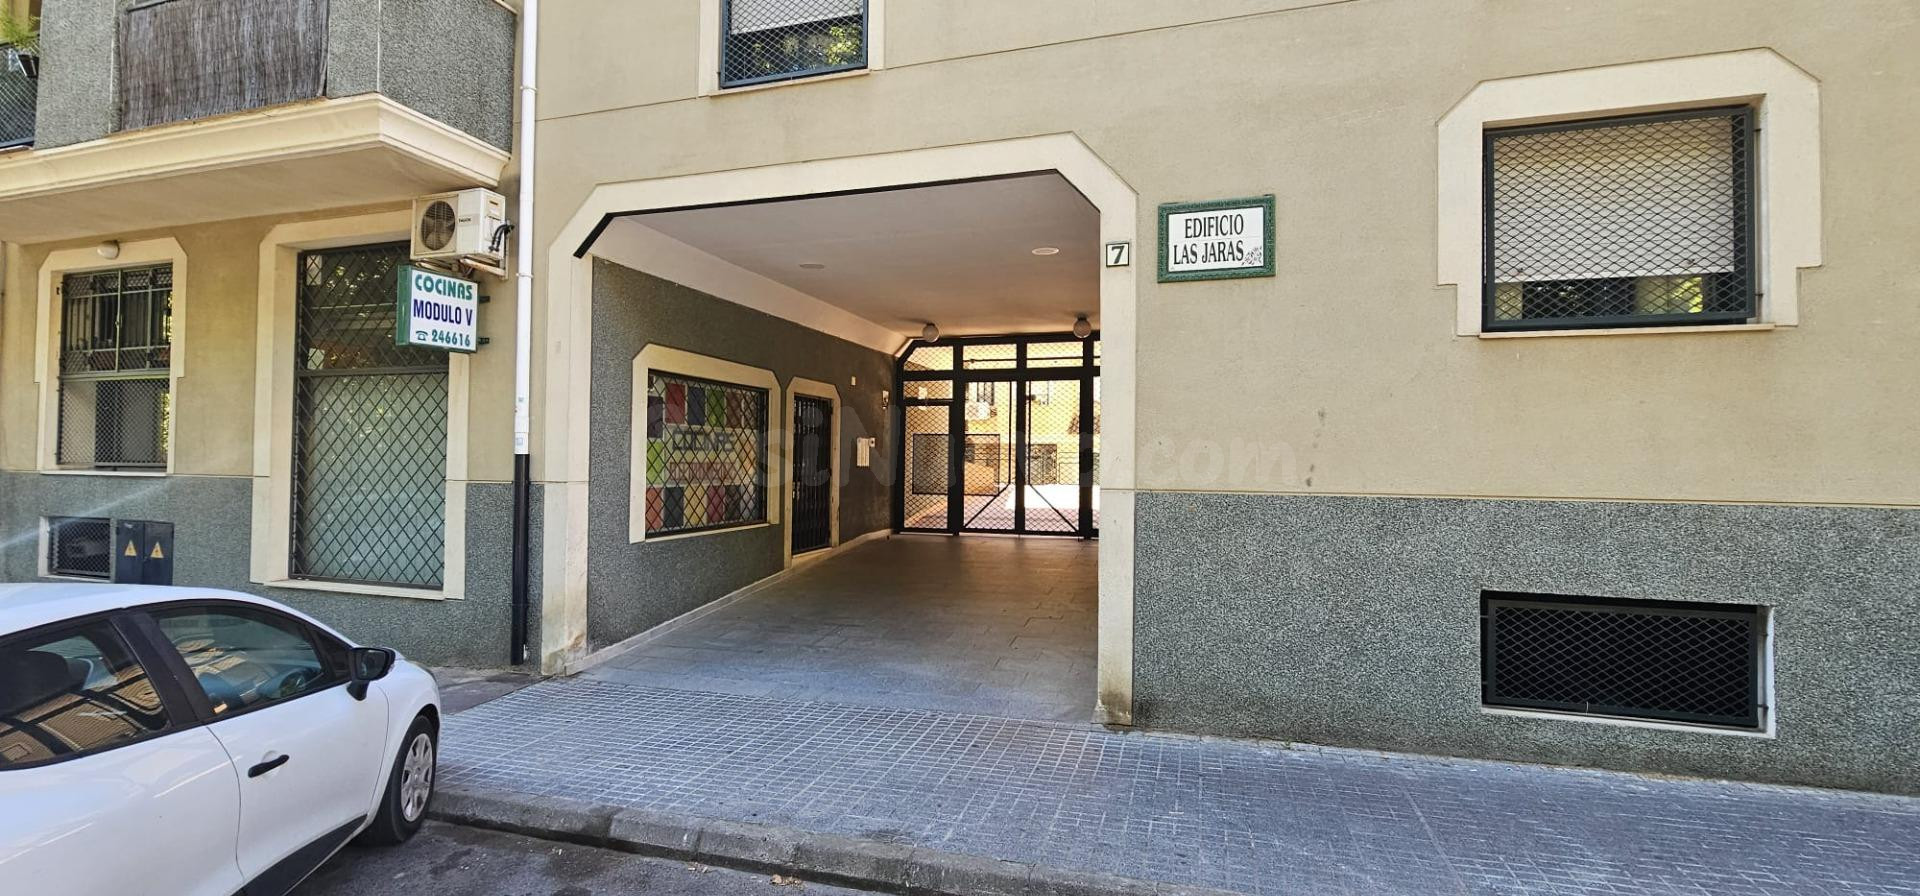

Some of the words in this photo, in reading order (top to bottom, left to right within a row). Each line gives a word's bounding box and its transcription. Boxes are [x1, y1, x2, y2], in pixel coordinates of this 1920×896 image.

[1184, 213, 1244, 239] EDIFICIO
[1111, 245, 1125, 264] 7
[1173, 243, 1198, 265] LAS
[1201, 240, 1244, 264] JARAS
[414, 273, 473, 301] COCINAS
[413, 298, 462, 325] MODULO
[465, 307, 473, 327] V
[431, 328, 471, 347] 246616
